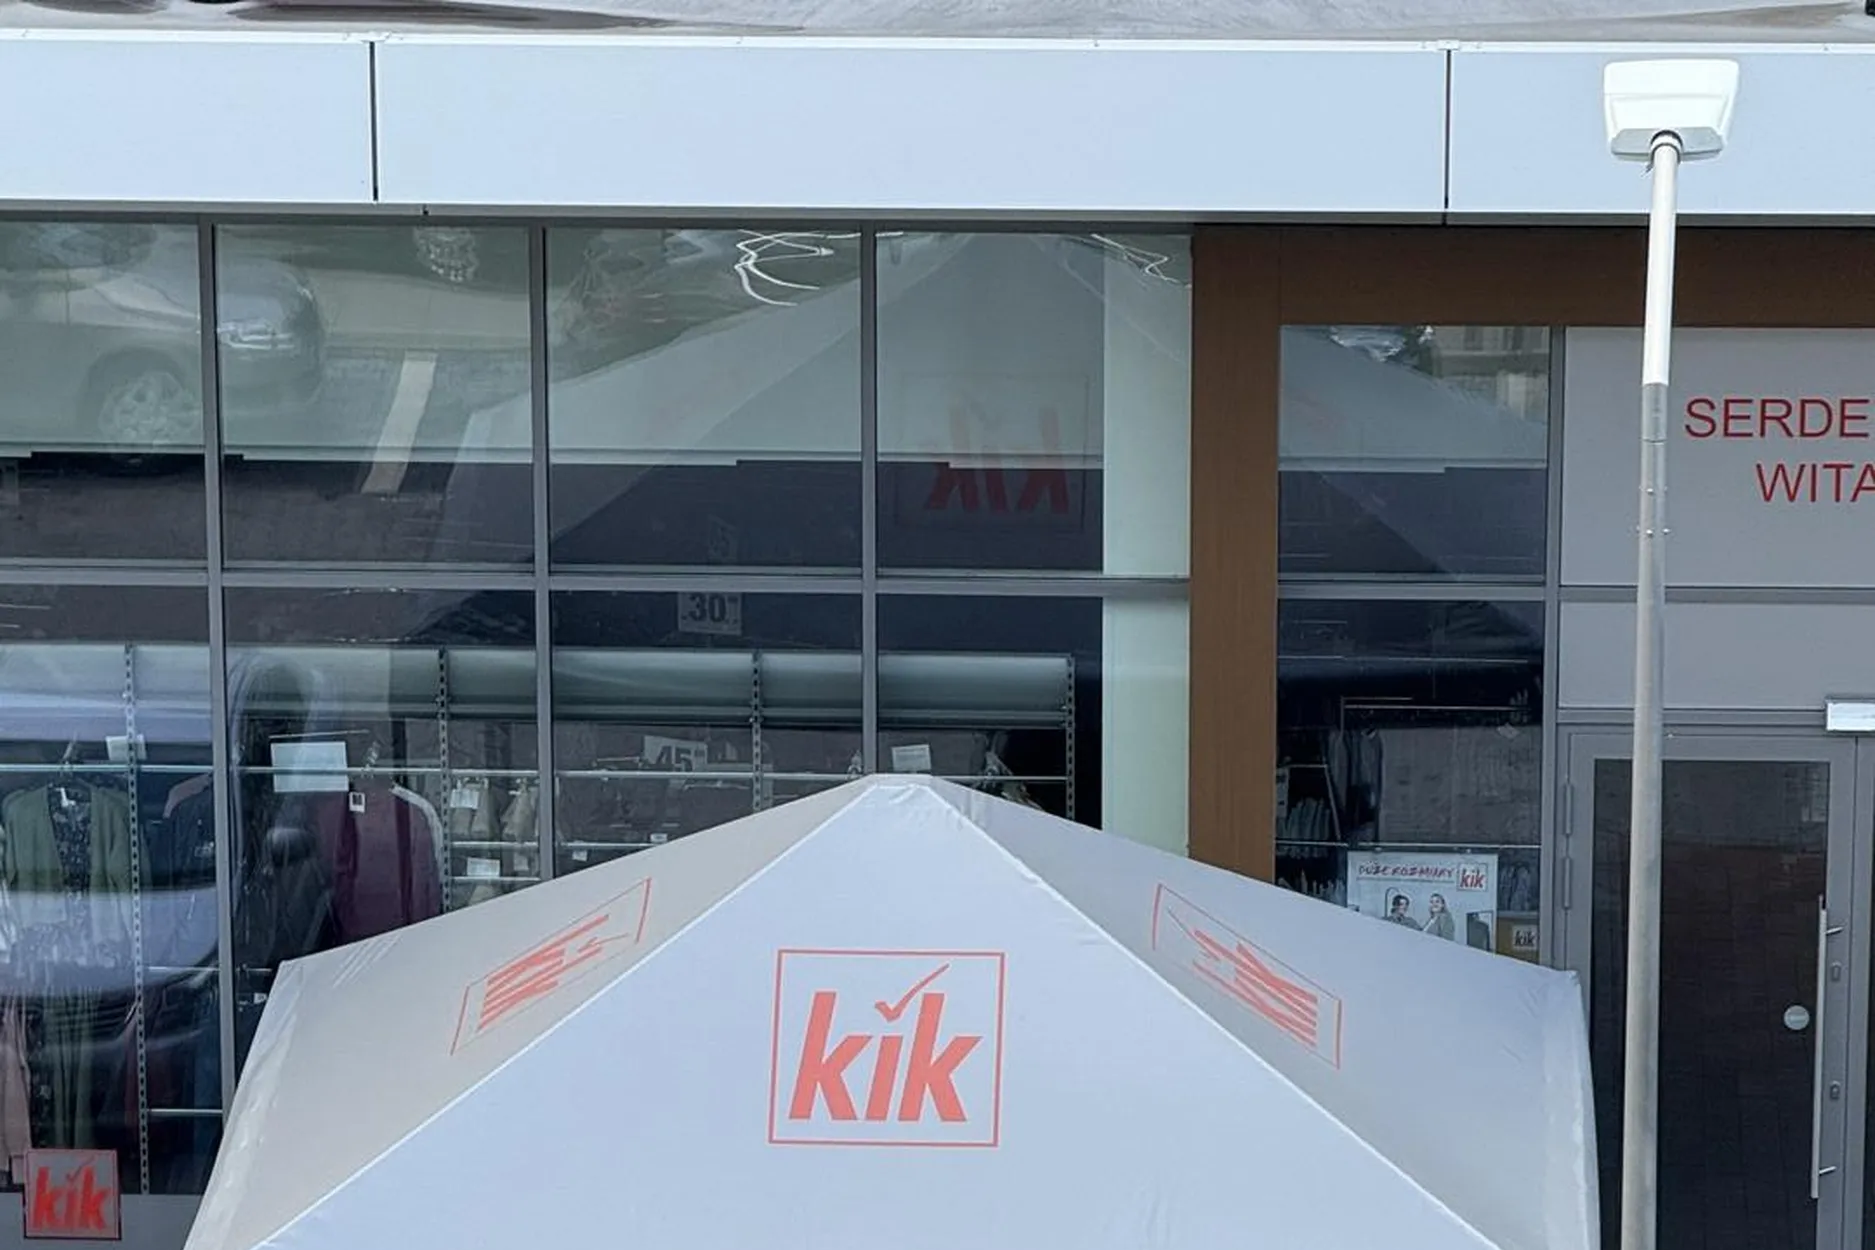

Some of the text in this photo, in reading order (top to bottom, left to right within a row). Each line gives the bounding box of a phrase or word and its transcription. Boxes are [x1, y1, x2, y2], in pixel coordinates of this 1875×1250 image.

[1685, 397, 1870, 438] SERDE
[1756, 463, 1875, 502] WITA
[1459, 868, 1486, 889] kik
[788, 963, 984, 1122] kik
[32, 1157, 112, 1231] kik
